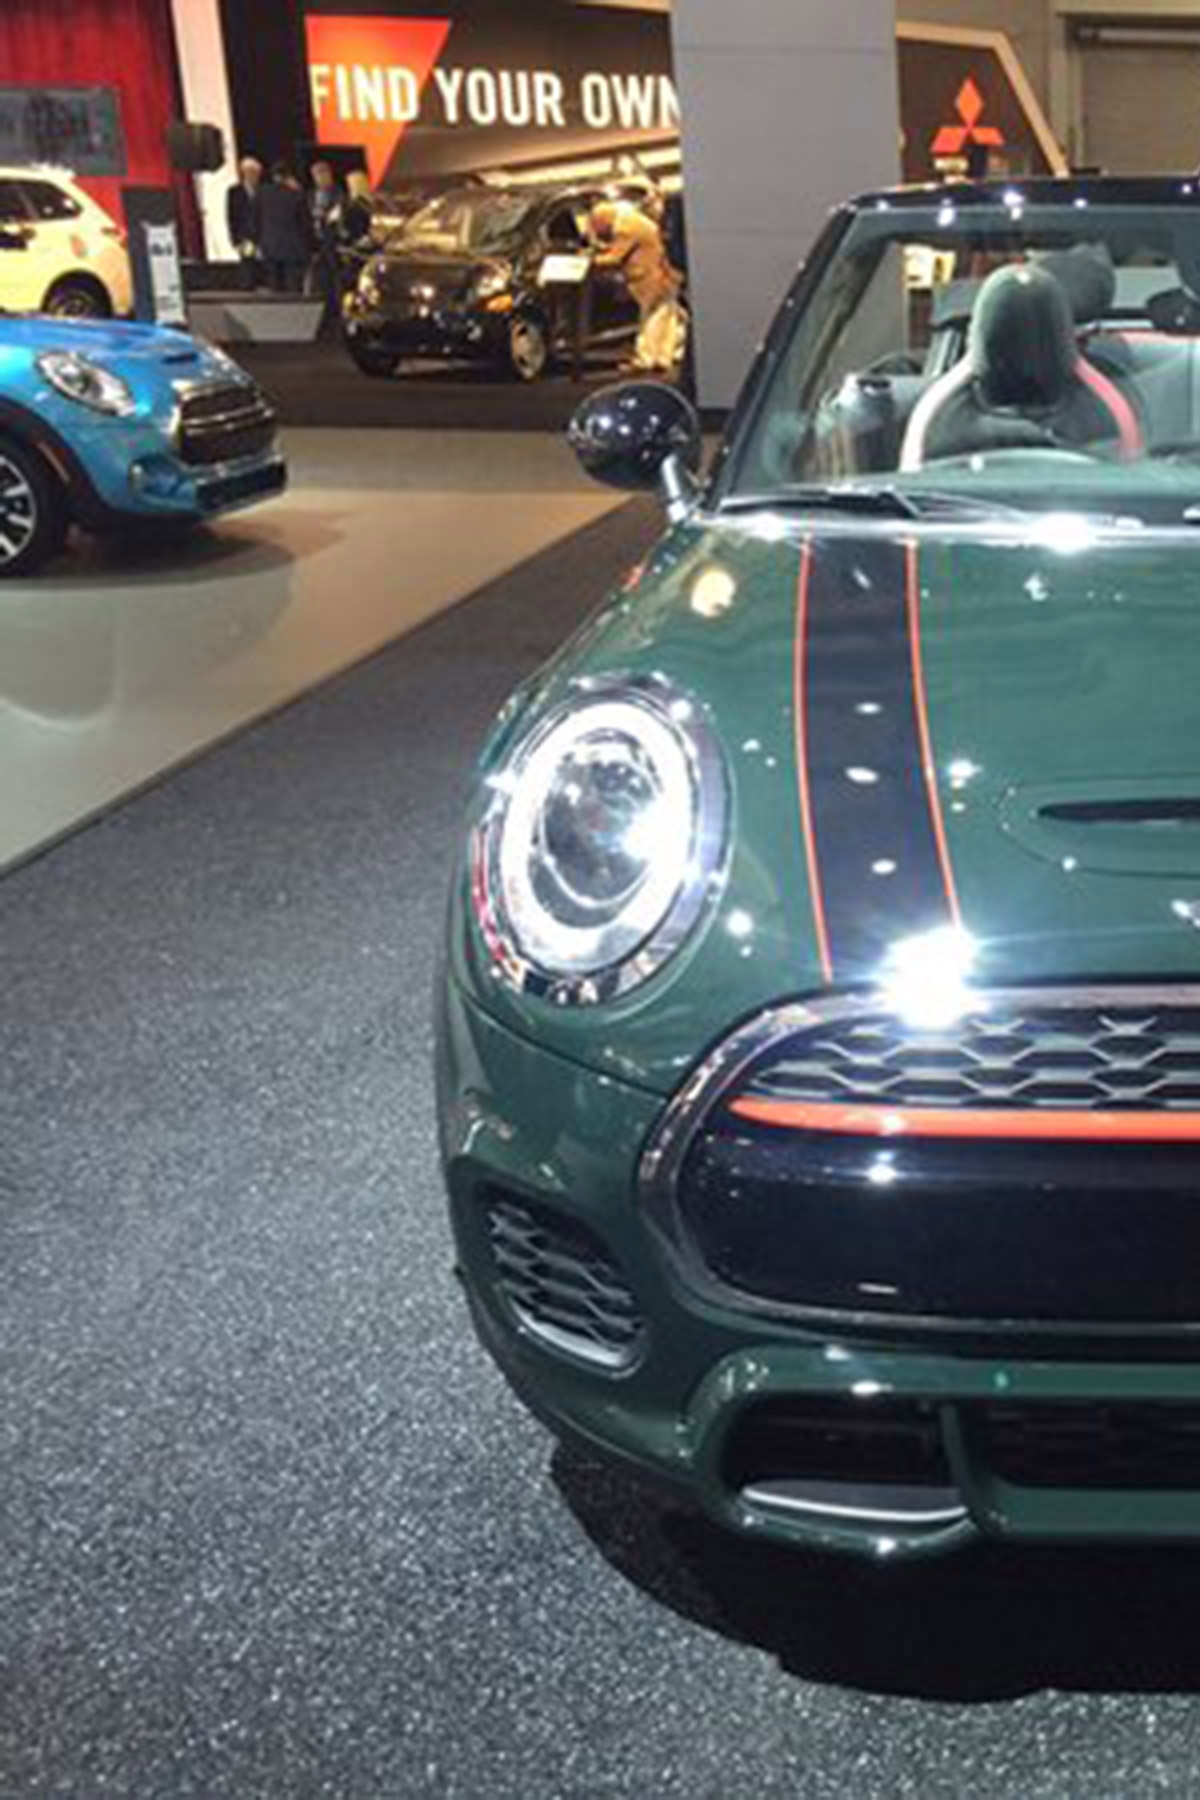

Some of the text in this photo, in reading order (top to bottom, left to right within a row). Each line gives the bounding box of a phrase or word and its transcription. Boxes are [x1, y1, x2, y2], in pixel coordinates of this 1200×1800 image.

[309, 63, 681, 128] FIND YOUR OWN
